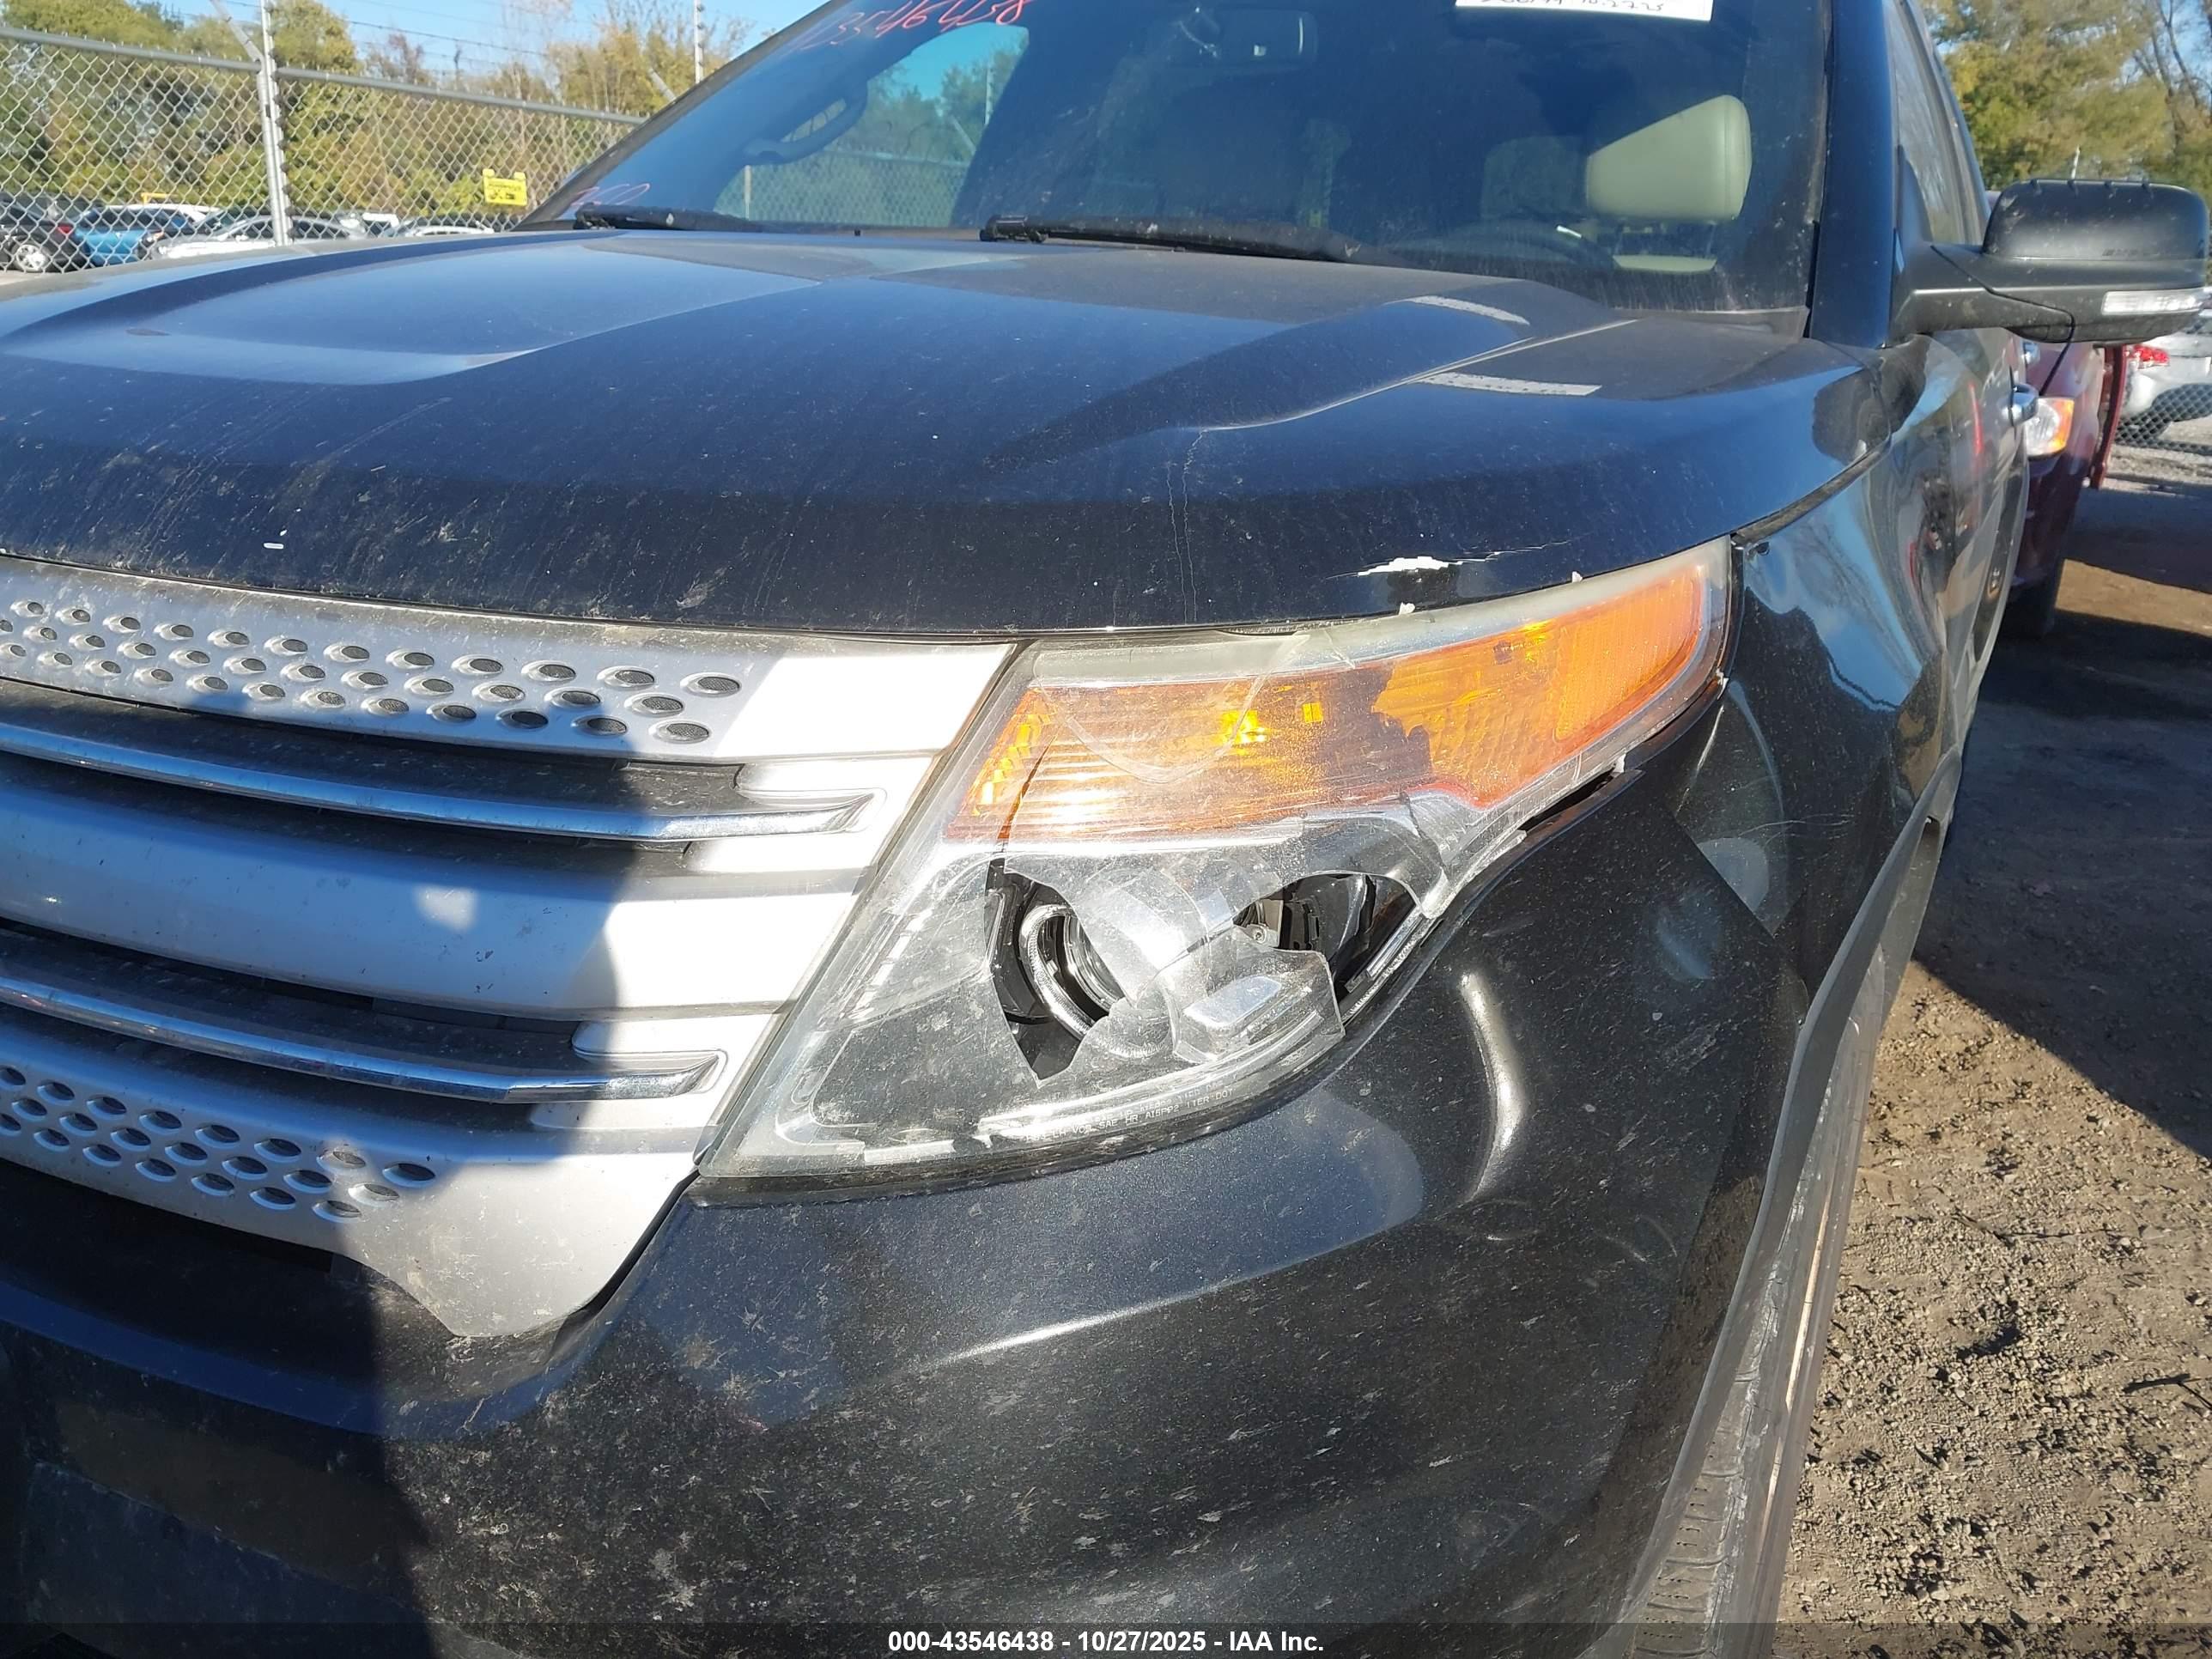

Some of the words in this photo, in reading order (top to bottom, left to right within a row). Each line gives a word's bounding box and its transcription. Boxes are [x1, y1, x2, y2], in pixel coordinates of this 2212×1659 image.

[1098, 1118, 1117, 1128] SAE
[1126, 1114, 1139, 1124] HR
[1215, 1090, 1234, 1101] DOT
